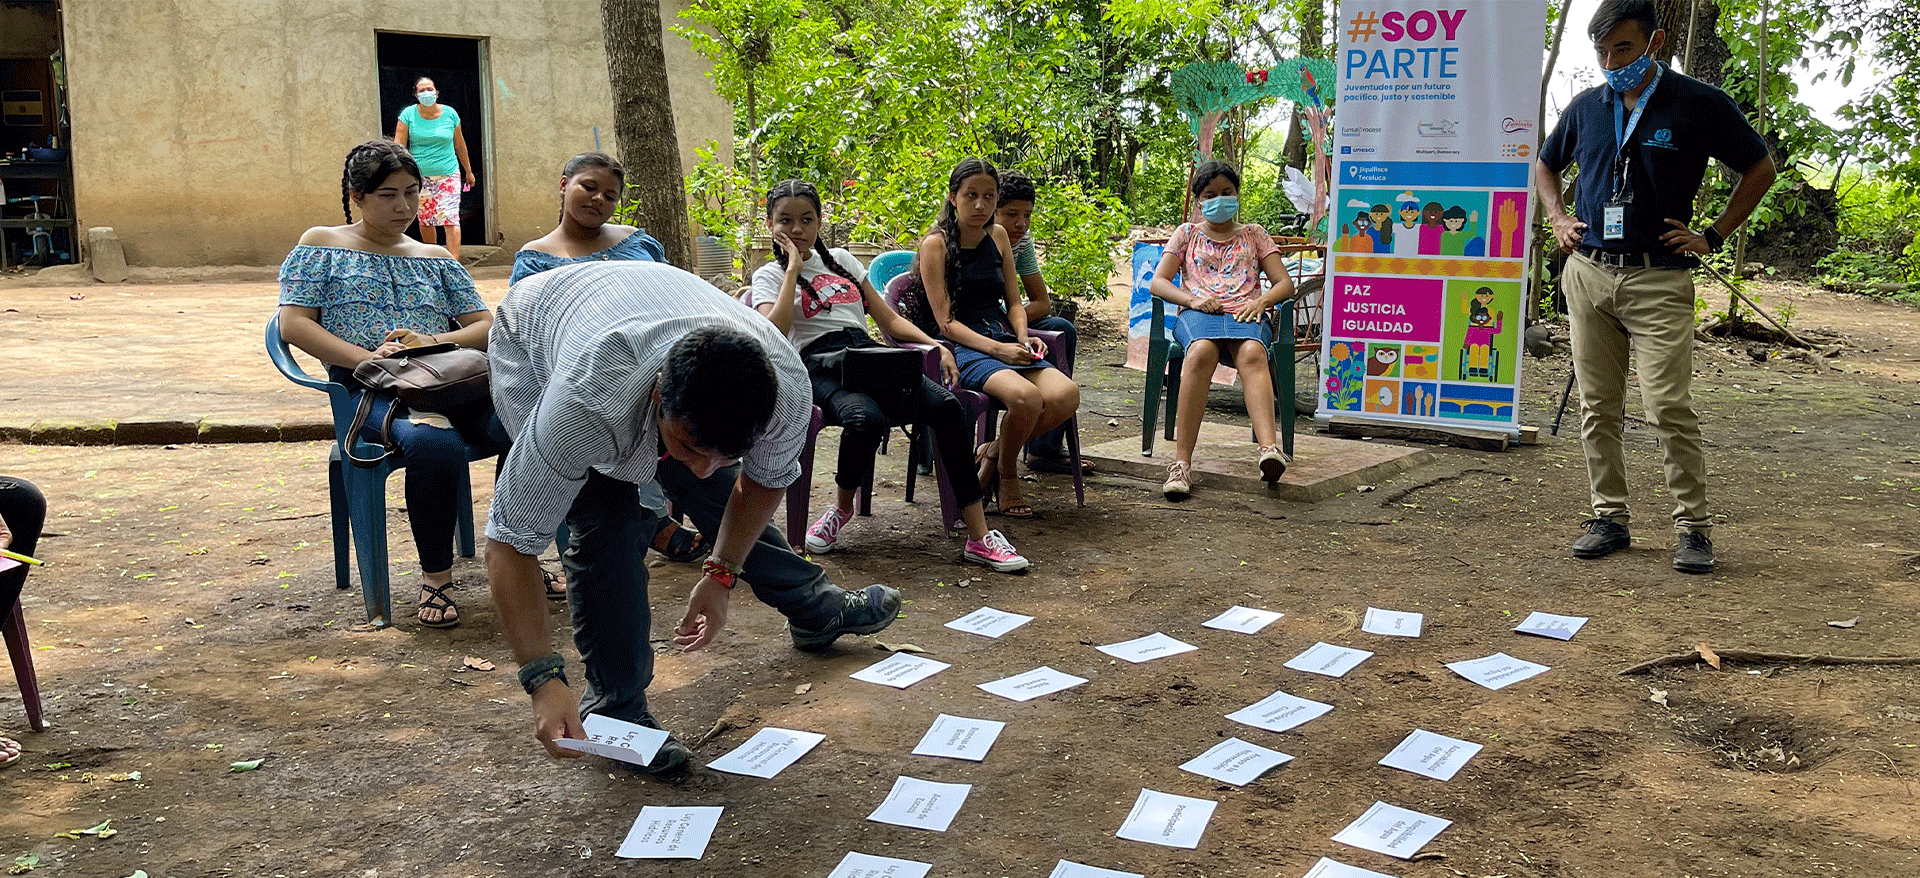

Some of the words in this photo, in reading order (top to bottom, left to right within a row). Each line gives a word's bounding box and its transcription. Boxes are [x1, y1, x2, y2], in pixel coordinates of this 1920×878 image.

[1347, 9, 1467, 42] #SOY
[1346, 47, 1459, 79] PARTE
[1395, 84, 1410, 92] por
[1381, 93, 1402, 102] justo
[1404, 94, 1409, 102] y
[1344, 284, 1371, 296] PAZ
[1343, 302, 1406, 315] JUSTICIA
[1343, 319, 1413, 333] IGUALDAD
[622, 731, 639, 742] Ley
[655, 819, 677, 844] Recursos
